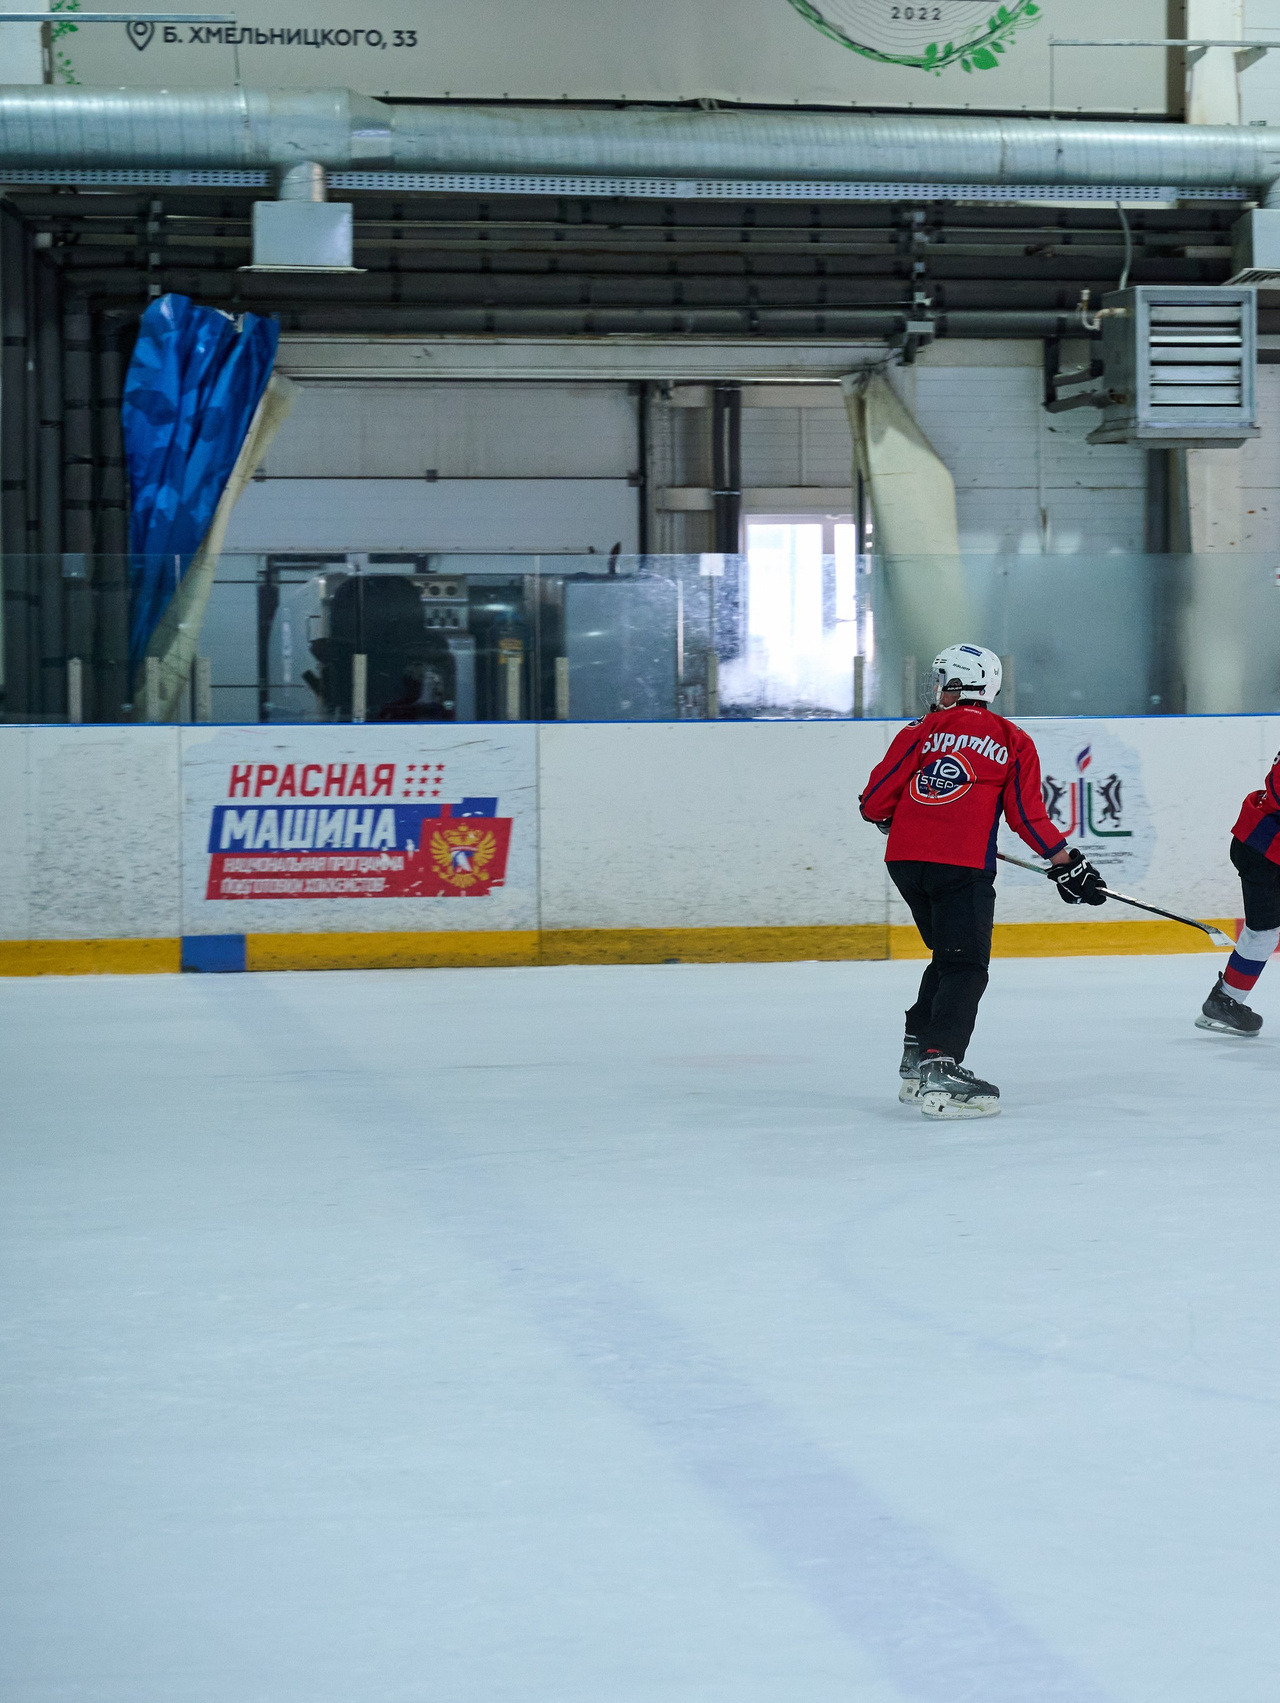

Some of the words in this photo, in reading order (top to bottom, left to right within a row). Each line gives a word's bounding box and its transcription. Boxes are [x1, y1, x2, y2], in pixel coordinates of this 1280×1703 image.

[891, 7, 941, 21] 2022
[163, 26, 183, 43] Б.
[189, 26, 388, 49] ХМЕЛЬНИЦКОГО,
[392, 29, 418, 47] 33
[227, 763, 396, 797] КРАСНАЯ
[932, 759, 960, 779] 10
[219, 808, 397, 849] МАШИНА
